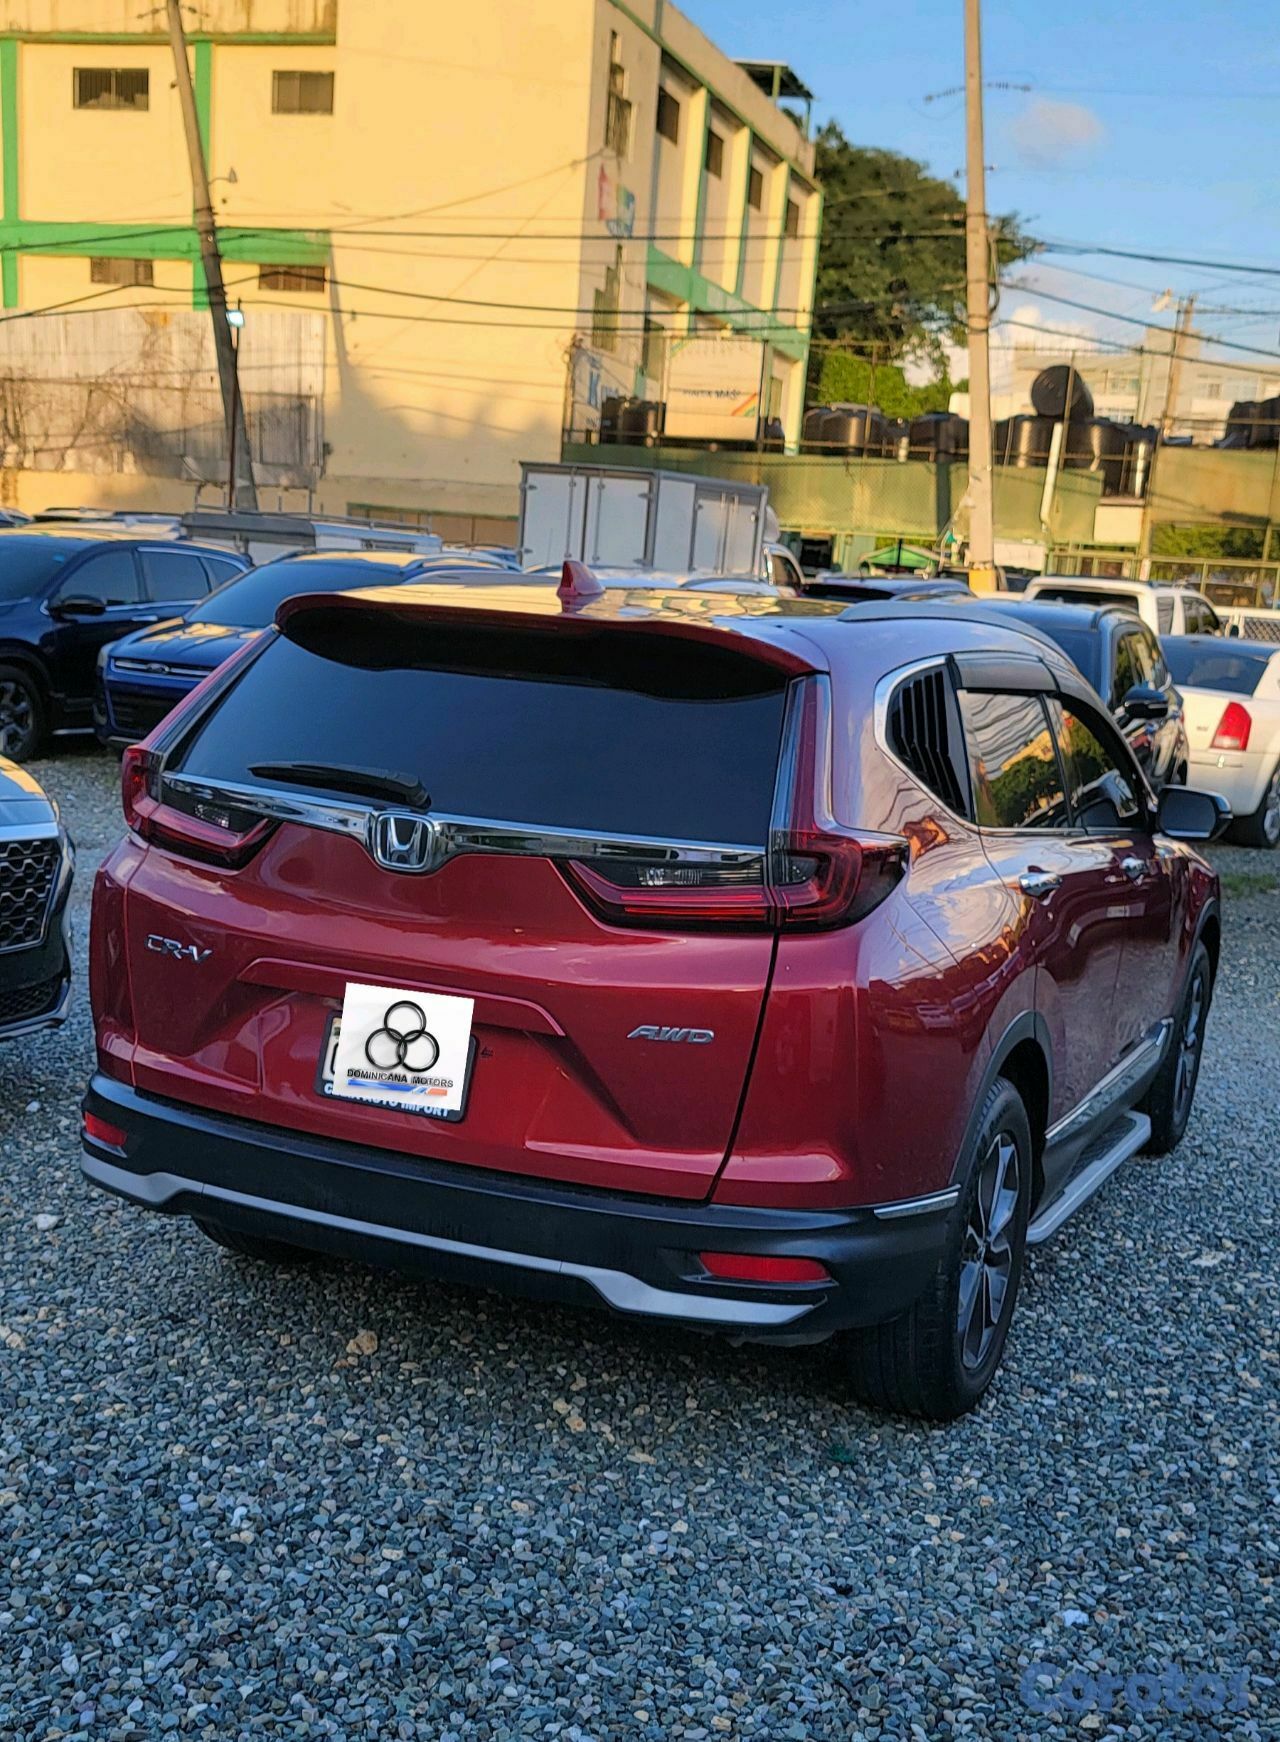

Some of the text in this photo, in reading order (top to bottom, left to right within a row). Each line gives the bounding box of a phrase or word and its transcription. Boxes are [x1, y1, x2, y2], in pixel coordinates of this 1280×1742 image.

[145, 934, 213, 963] CR-V
[626, 1025, 715, 1043] AWD
[401, 1100, 449, 1117] IMPORT
